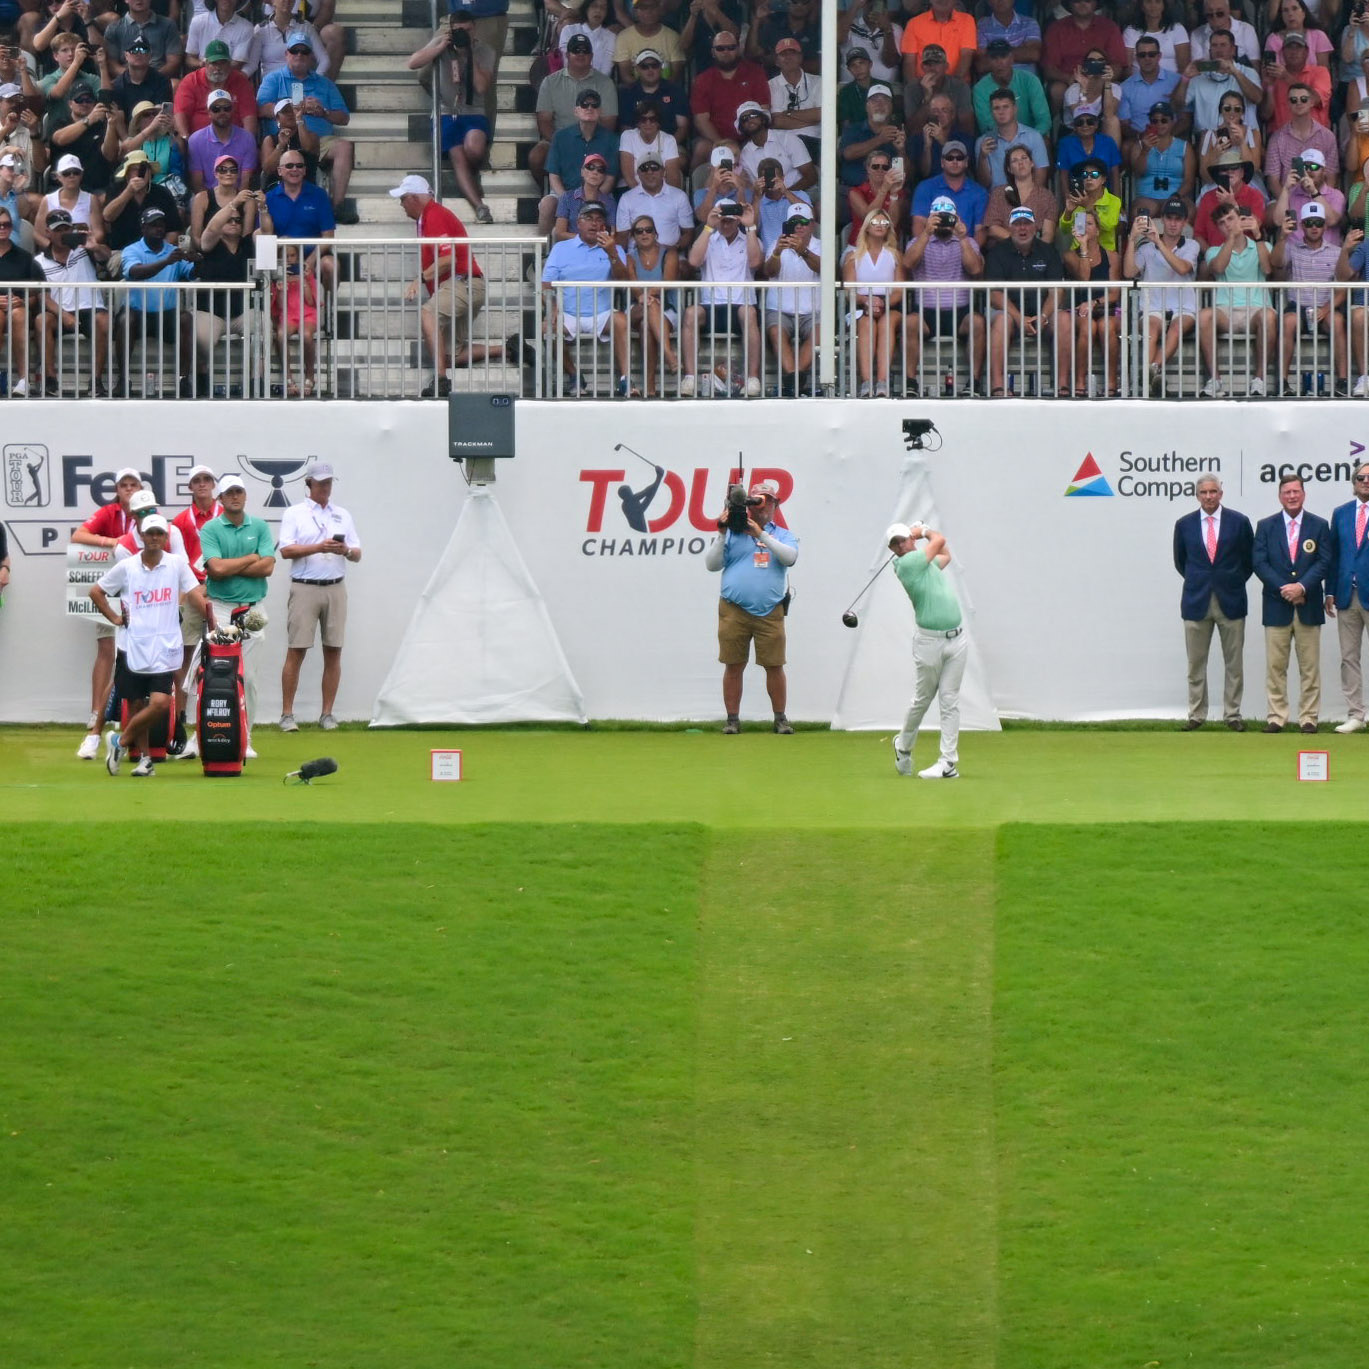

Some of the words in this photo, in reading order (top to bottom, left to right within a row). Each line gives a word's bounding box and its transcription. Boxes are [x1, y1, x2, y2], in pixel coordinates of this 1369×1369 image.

[1119, 450, 1221, 472] Southern
[9, 460, 24, 503] TOUR
[1118, 475, 1223, 502] Compa
[579, 468, 794, 534] TOUR
[78, 551, 110, 561] TOUR
[582, 537, 717, 557] CHAMPIO
[69, 571, 105, 583] SCHEFF
[134, 587, 172, 605] TOUR
[210, 699, 228, 708] RORY
